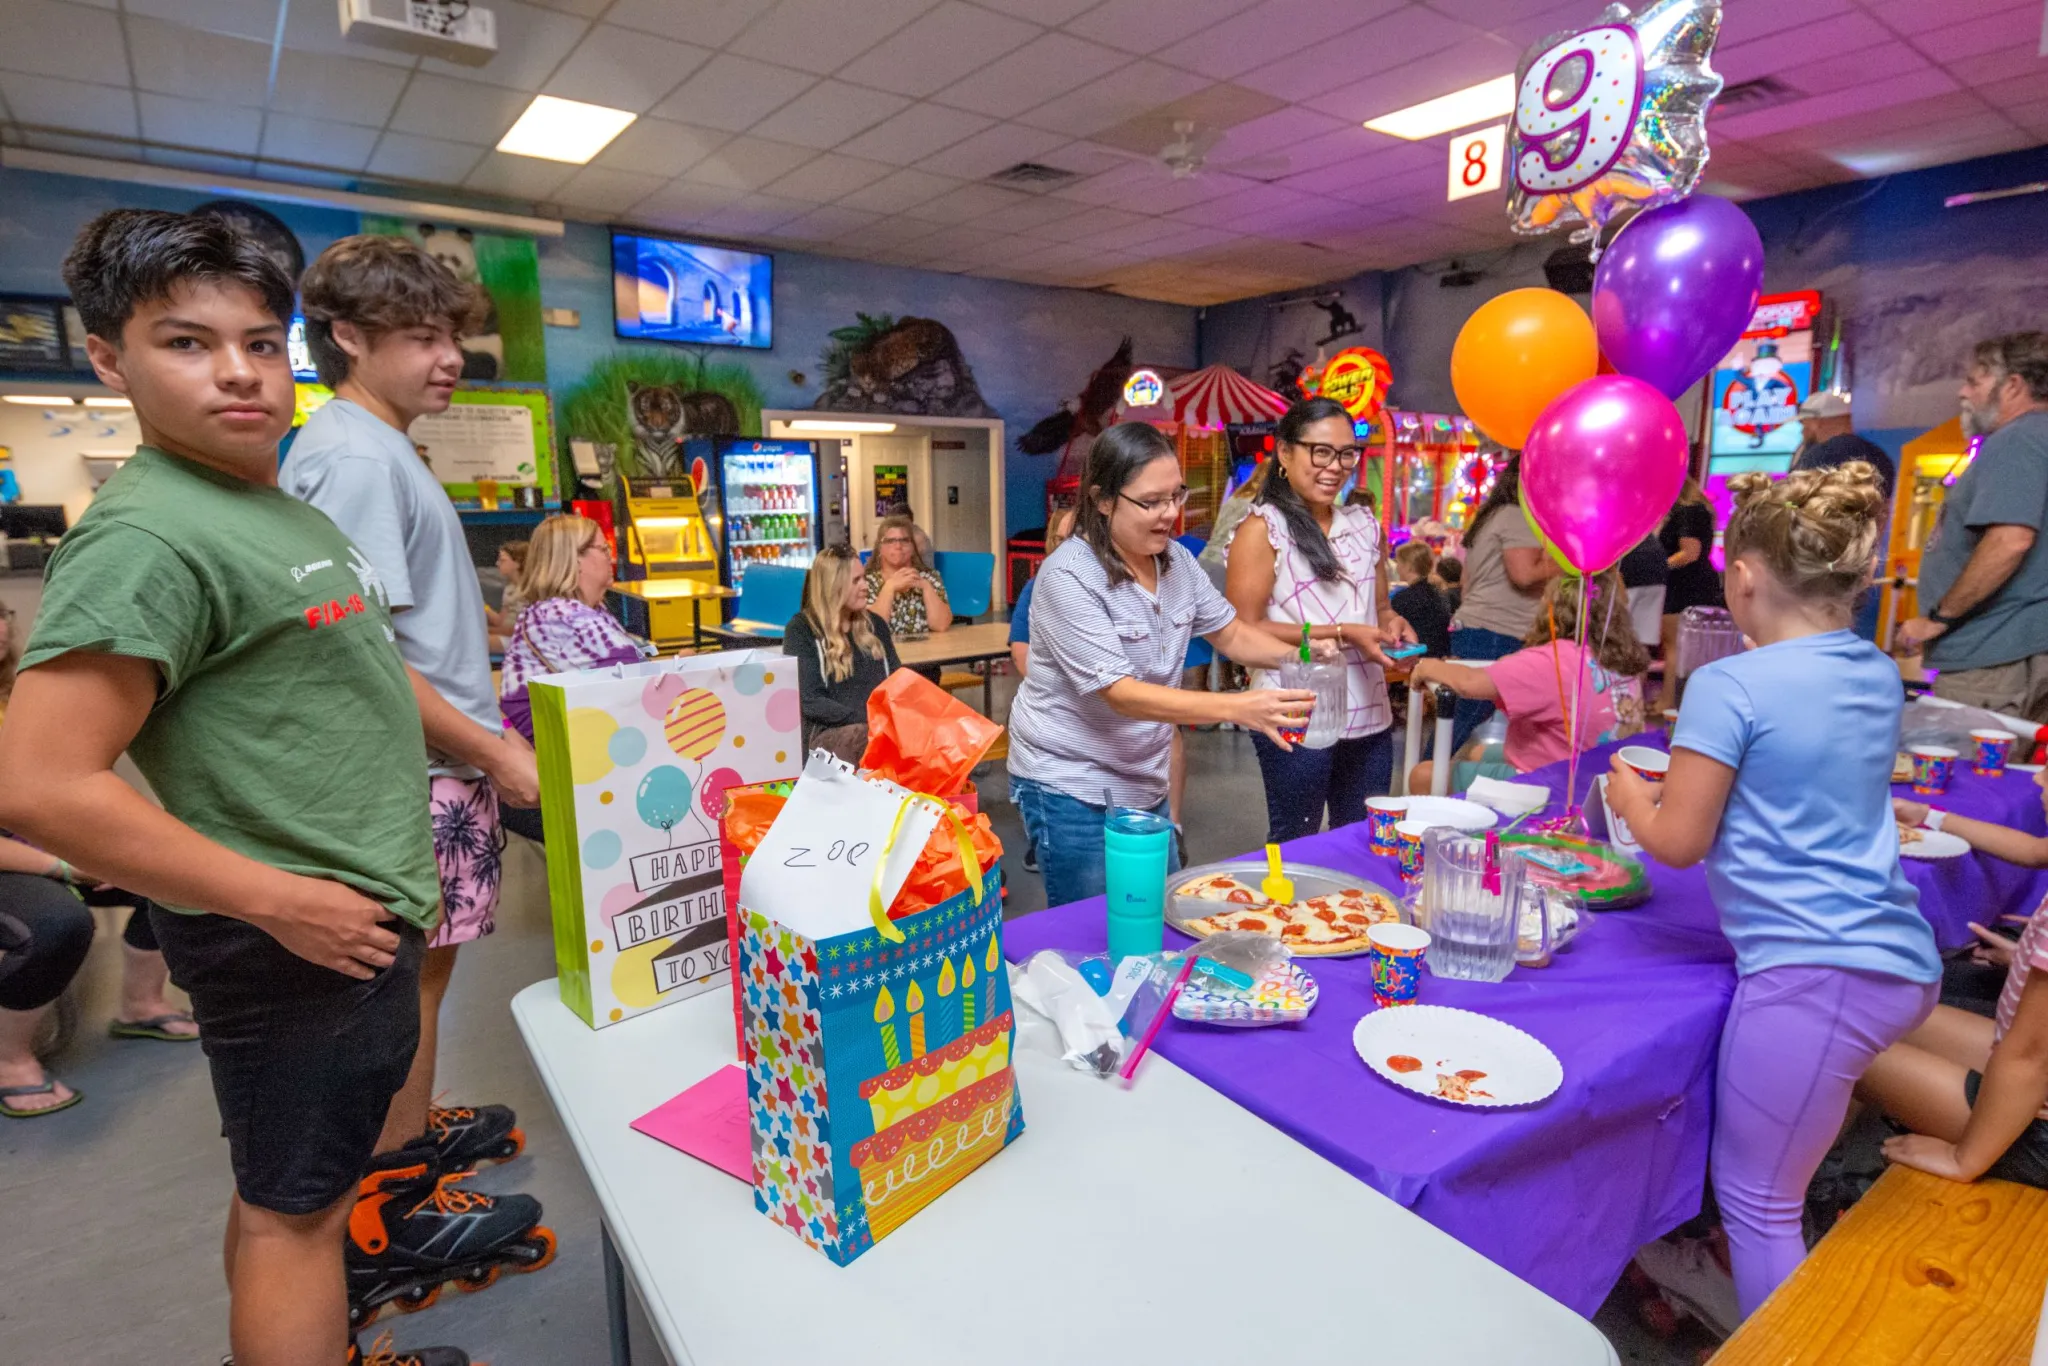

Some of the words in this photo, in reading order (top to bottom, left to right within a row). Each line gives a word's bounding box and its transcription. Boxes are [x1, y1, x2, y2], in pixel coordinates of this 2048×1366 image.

[1516, 23, 1645, 196] 9
[1462, 139, 1488, 187] 8
[651, 845, 721, 881] HAPP
[628, 890, 727, 944] BIRTH
[666, 956, 696, 984] TO
[703, 944, 731, 971] YO
